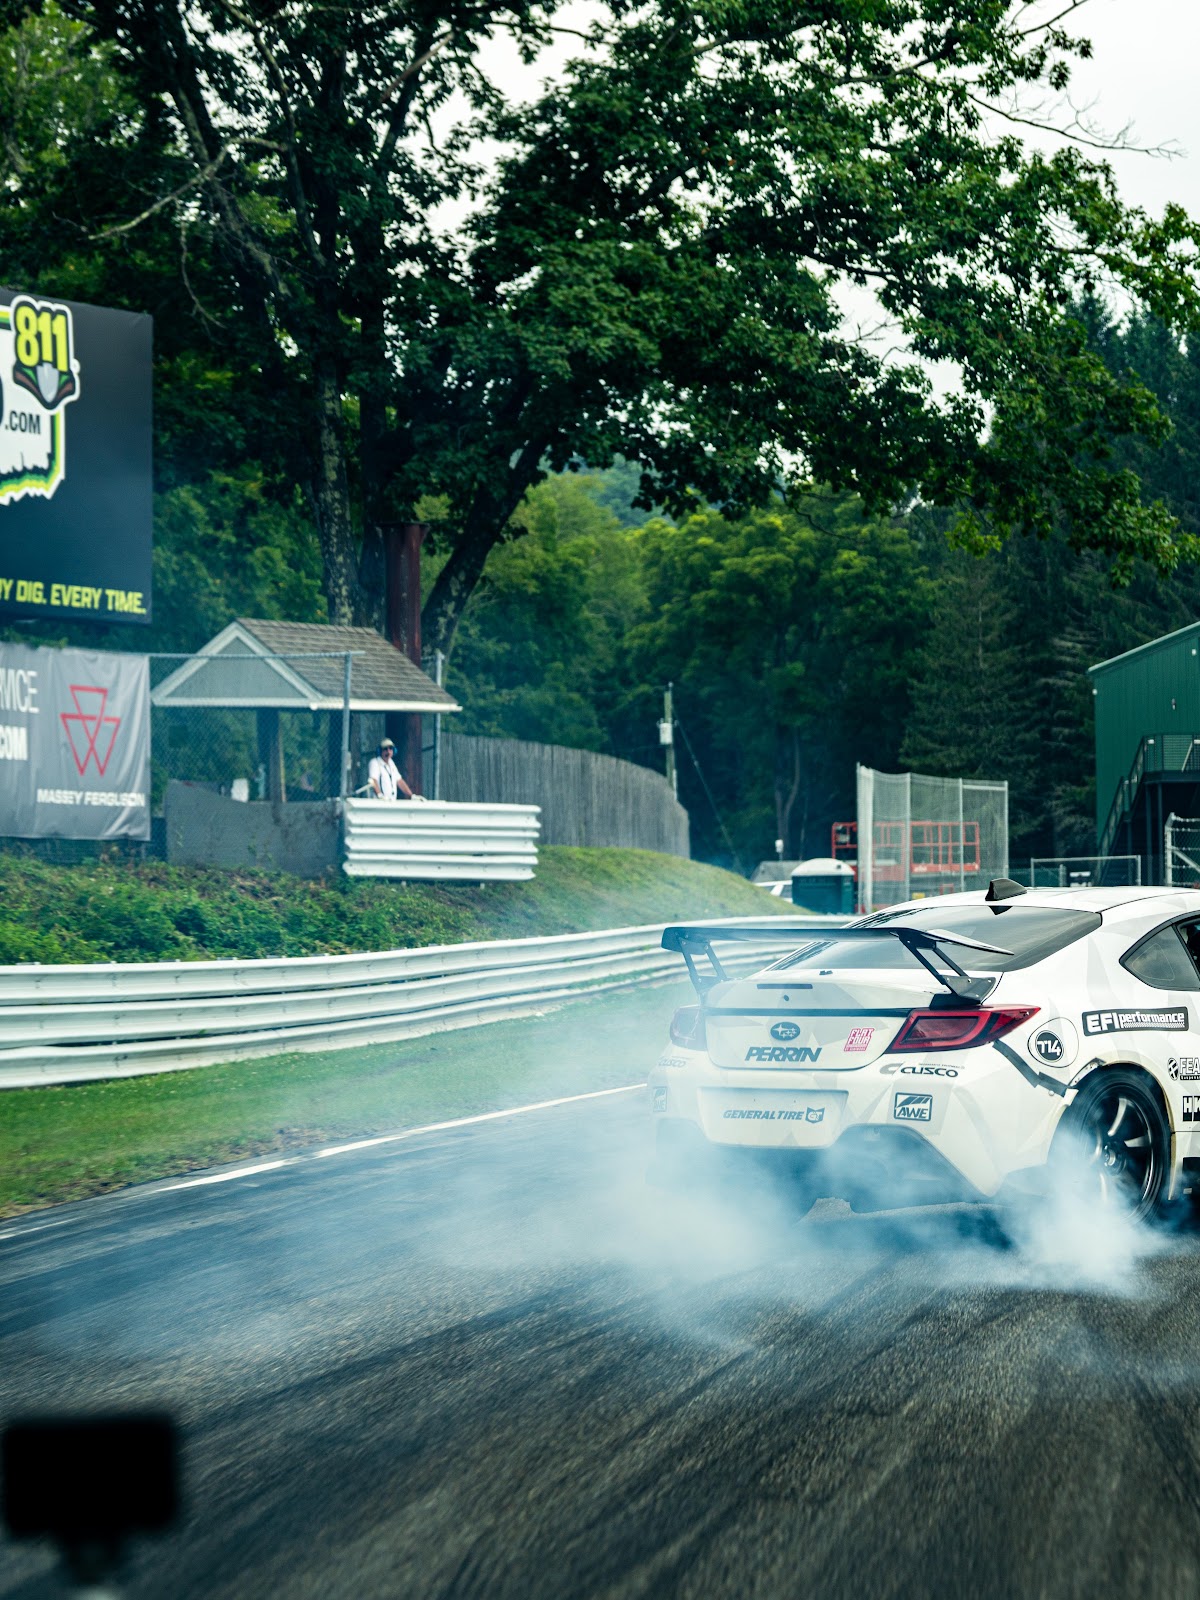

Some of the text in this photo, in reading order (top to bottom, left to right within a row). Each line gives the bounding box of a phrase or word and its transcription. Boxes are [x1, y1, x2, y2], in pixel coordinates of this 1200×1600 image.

[16, 305, 69, 372] 811
[5, 411, 41, 434] .COM
[16, 580, 46, 604] DIG.
[50, 583, 102, 609] EVERY
[105, 588, 146, 614] TIME.
[37, 788, 145, 807] MASSEY FERGUSON
[1086, 1011, 1185, 1032] EFI performance
[847, 1036, 871, 1045] FOUR
[850, 1028, 875, 1037] FLAT
[744, 1047, 822, 1062] PERRIN
[901, 1067, 959, 1078] CUSCO
[897, 1107, 928, 1119] AWE
